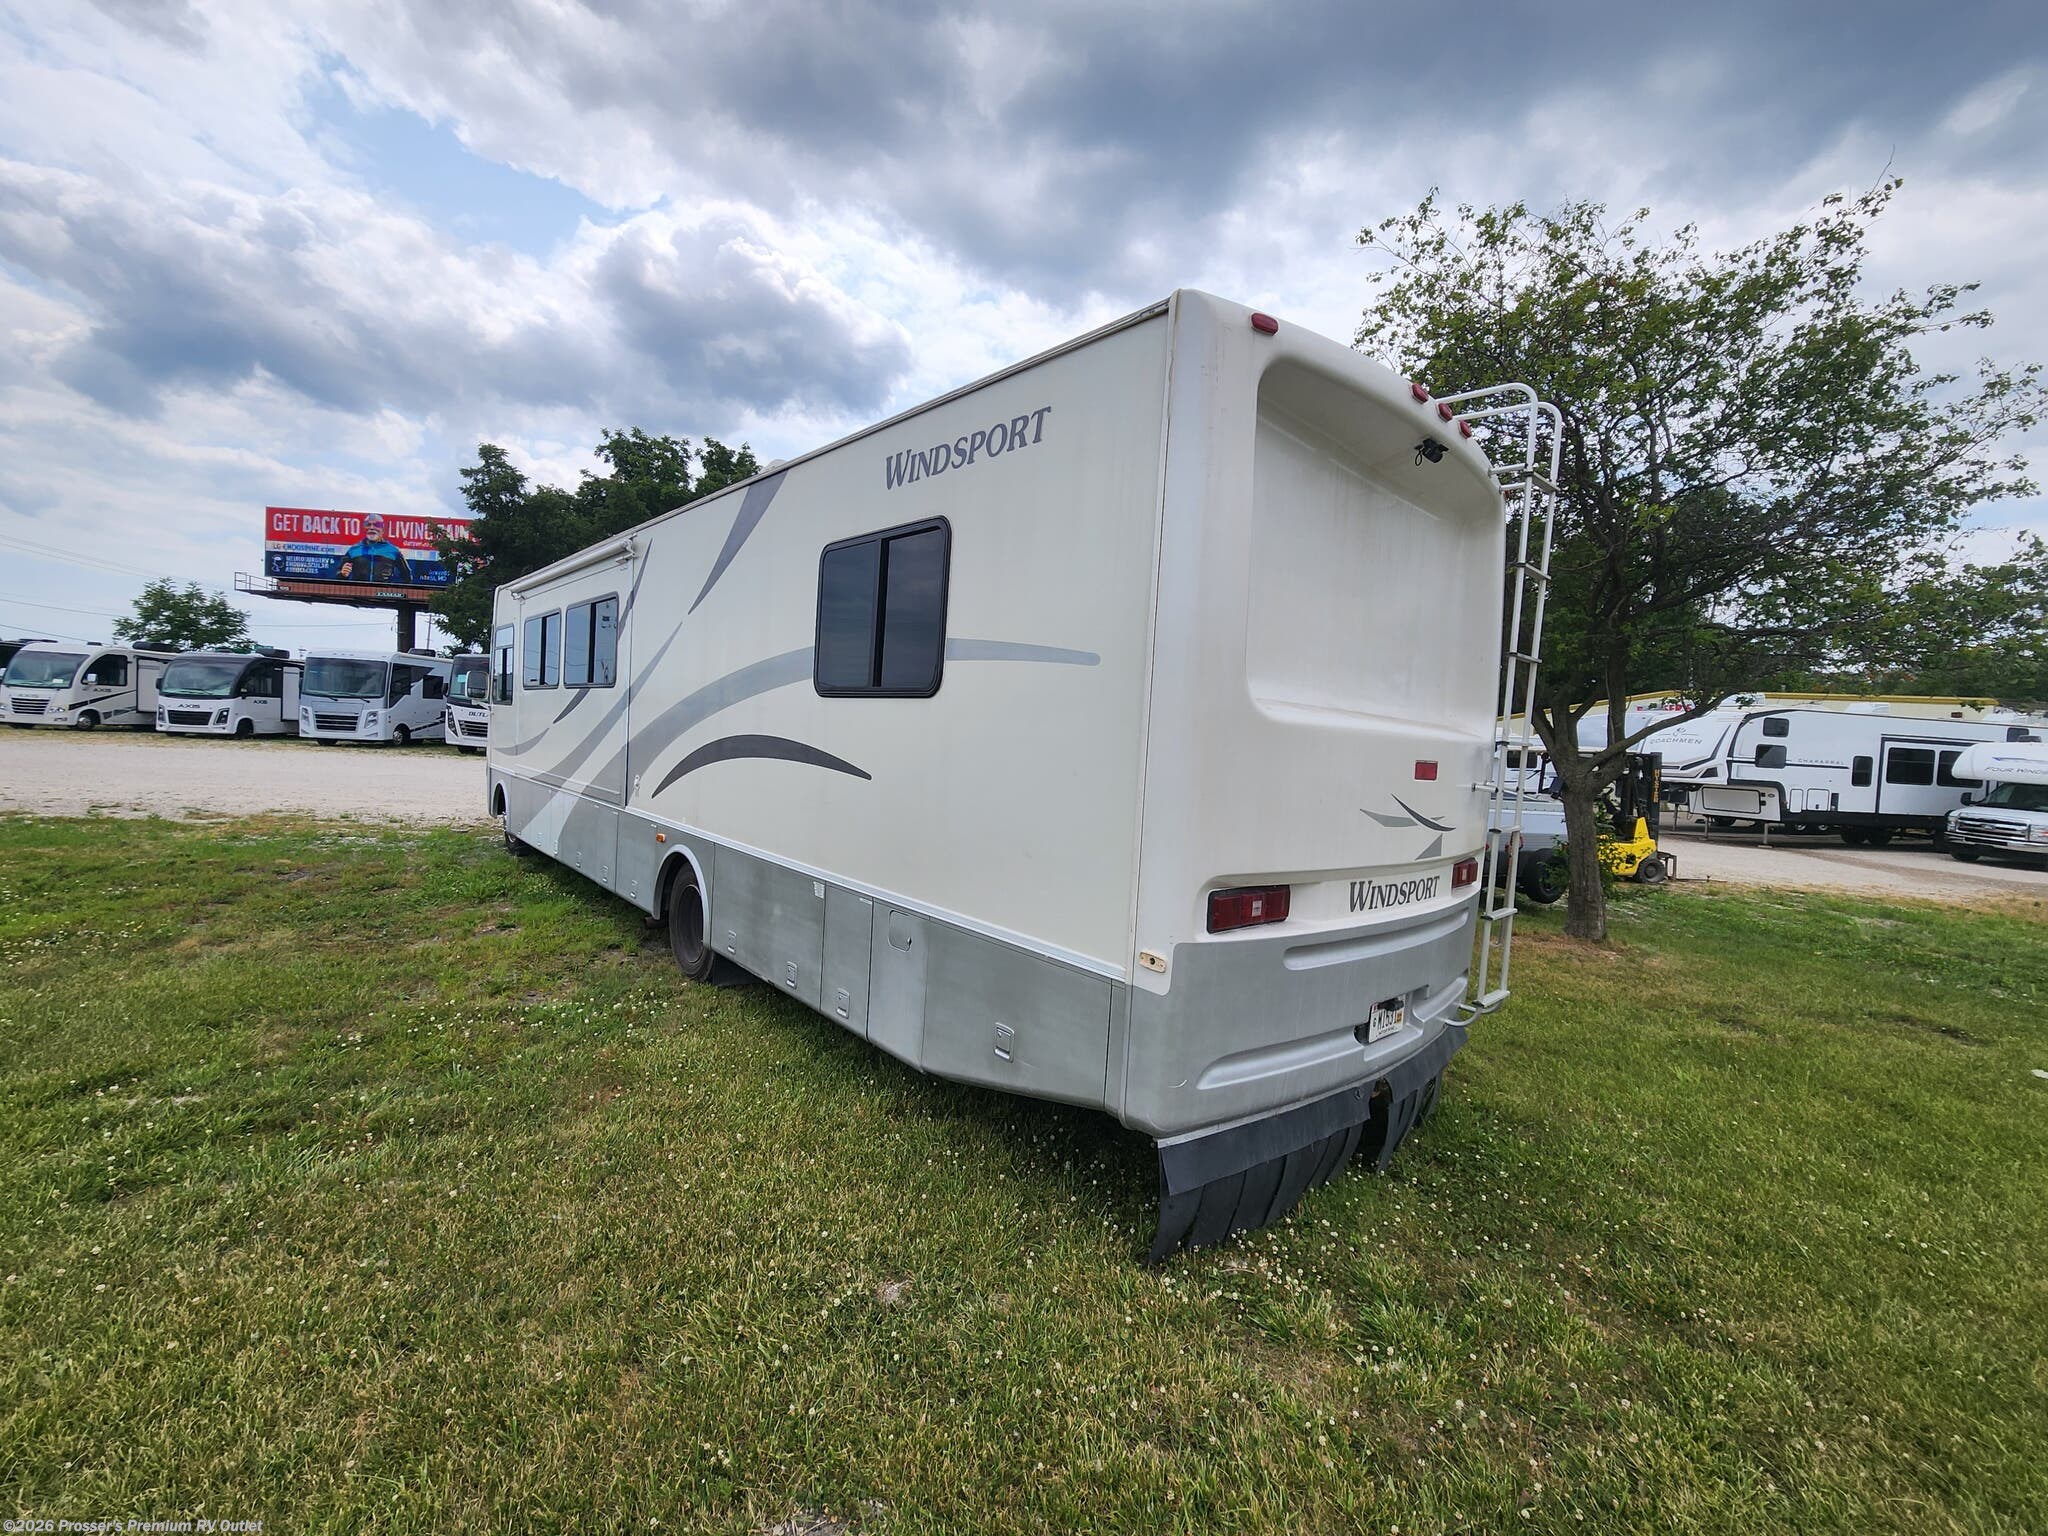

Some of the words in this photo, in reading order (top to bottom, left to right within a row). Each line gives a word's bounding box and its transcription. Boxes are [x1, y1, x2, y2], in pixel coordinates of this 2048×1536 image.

[886, 405, 1052, 490] WINDSPORT
[273, 513, 300, 532] GET
[302, 515, 341, 535] BACK
[343, 517, 361, 536] TO
[1649, 737, 1703, 745] COACHMEN
[1349, 875, 1440, 913] WINDSPORT
